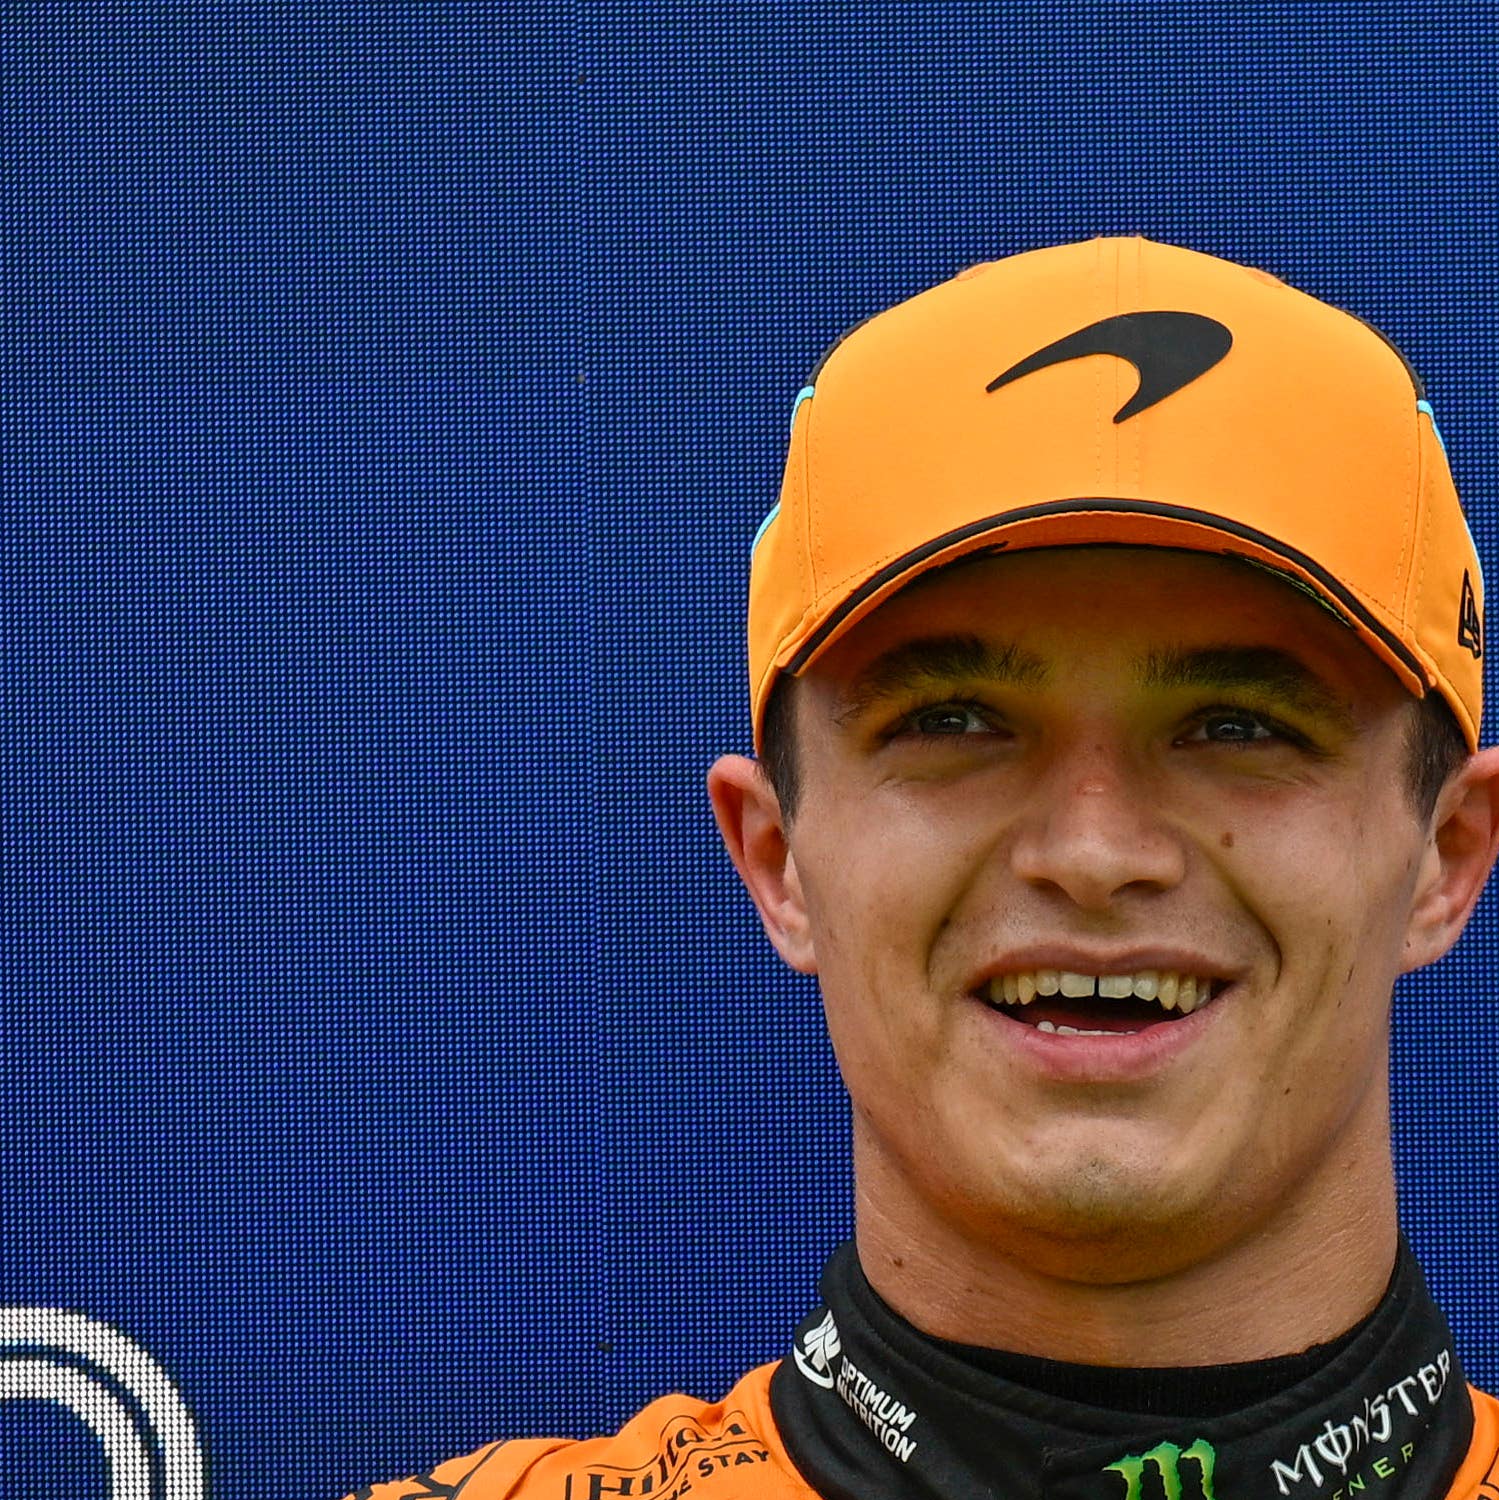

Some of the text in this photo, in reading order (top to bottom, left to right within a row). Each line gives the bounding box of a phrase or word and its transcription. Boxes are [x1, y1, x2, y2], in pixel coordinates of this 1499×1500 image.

[836, 1373, 918, 1464] NUTRITION
[841, 1354, 918, 1433] OPTIMUM
[697, 1449, 771, 1479] STAY
